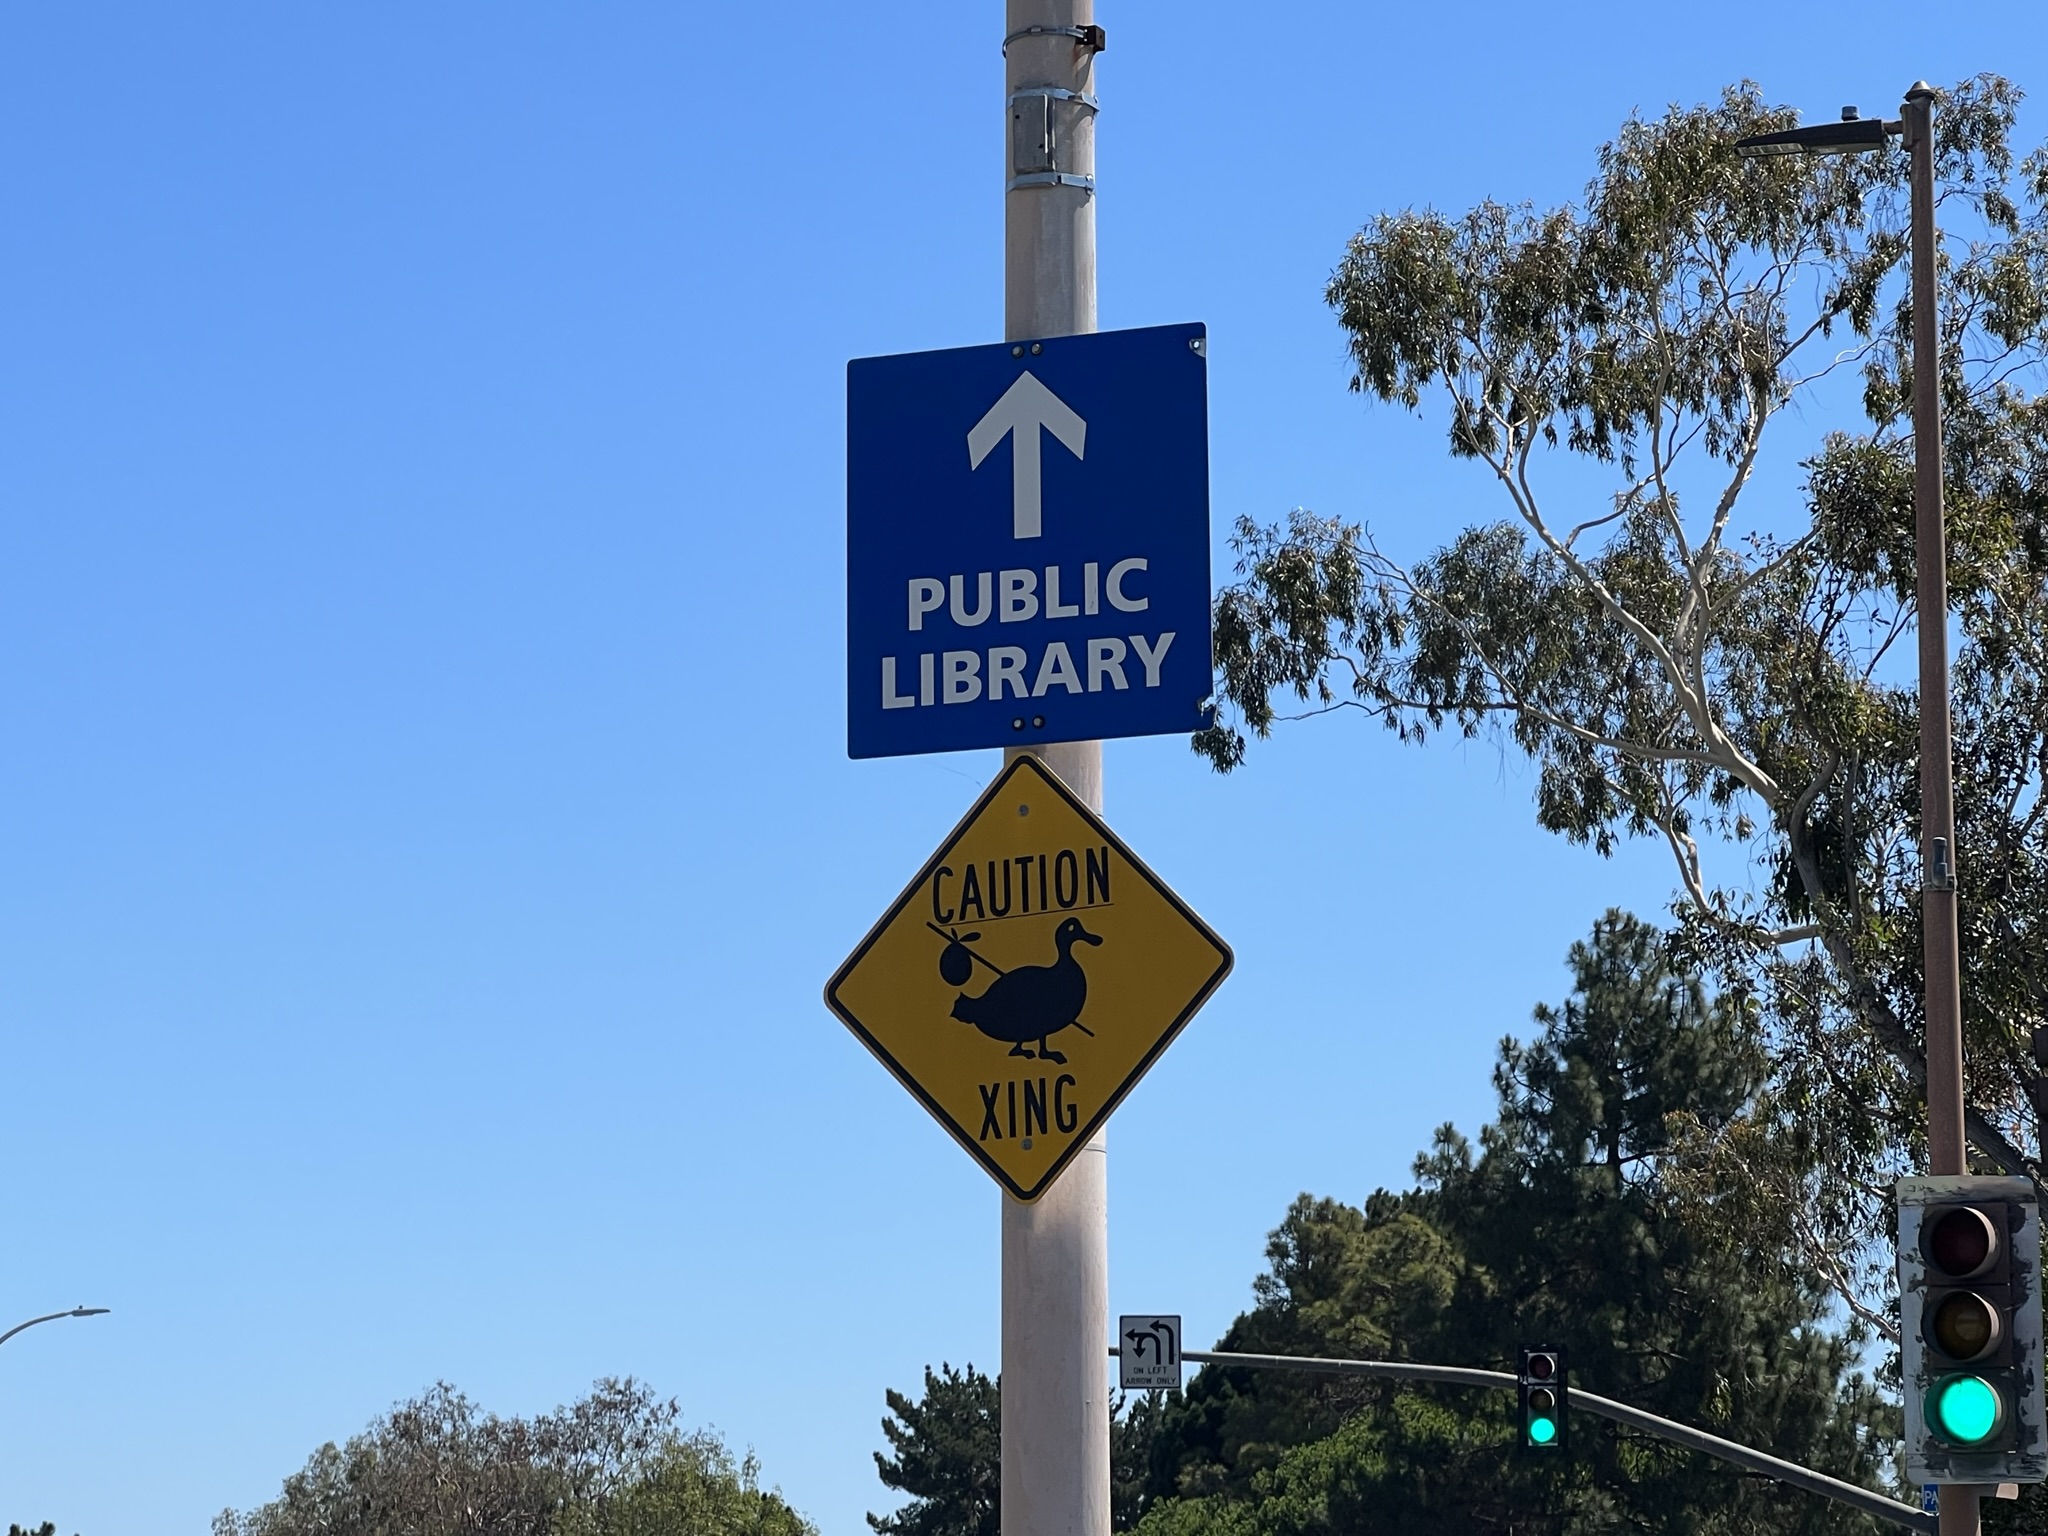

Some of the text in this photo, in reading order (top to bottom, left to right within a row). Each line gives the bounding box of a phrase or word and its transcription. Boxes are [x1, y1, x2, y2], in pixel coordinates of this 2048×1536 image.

[908, 558, 1149, 631] PUBLIC
[882, 632, 1176, 709] LIBRARY
[933, 846, 1111, 924] CAUTION
[979, 1074, 1078, 1141] XING
[1125, 1377, 1176, 1385] ARROW ONLY
[1133, 1367, 1167, 1375] ON LEFT
